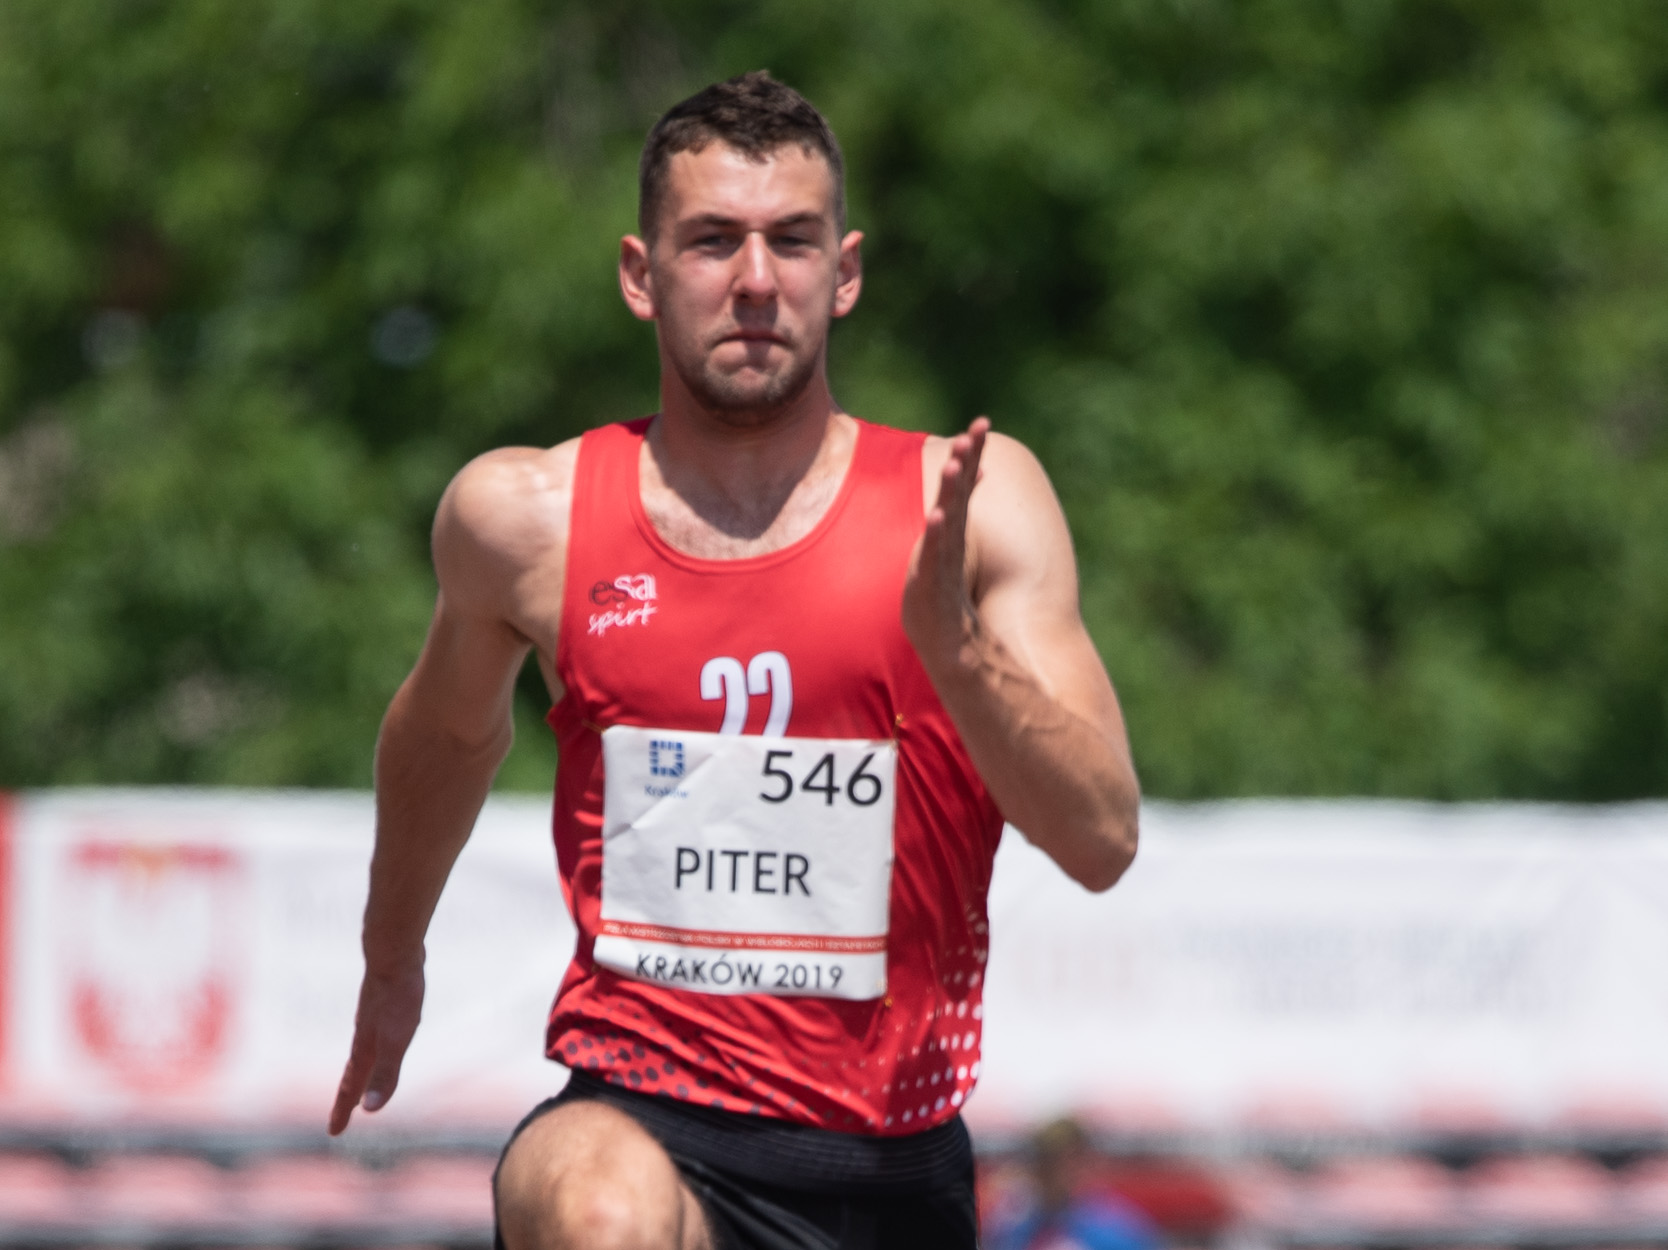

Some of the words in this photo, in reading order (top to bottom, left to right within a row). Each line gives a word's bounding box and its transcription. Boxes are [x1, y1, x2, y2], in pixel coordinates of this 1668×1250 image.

[589, 573, 657, 606] esa
[759, 749, 883, 807] 546
[675, 847, 811, 897] PITER
[635, 953, 763, 988] KRAKÓW
[774, 964, 844, 989] 2019
